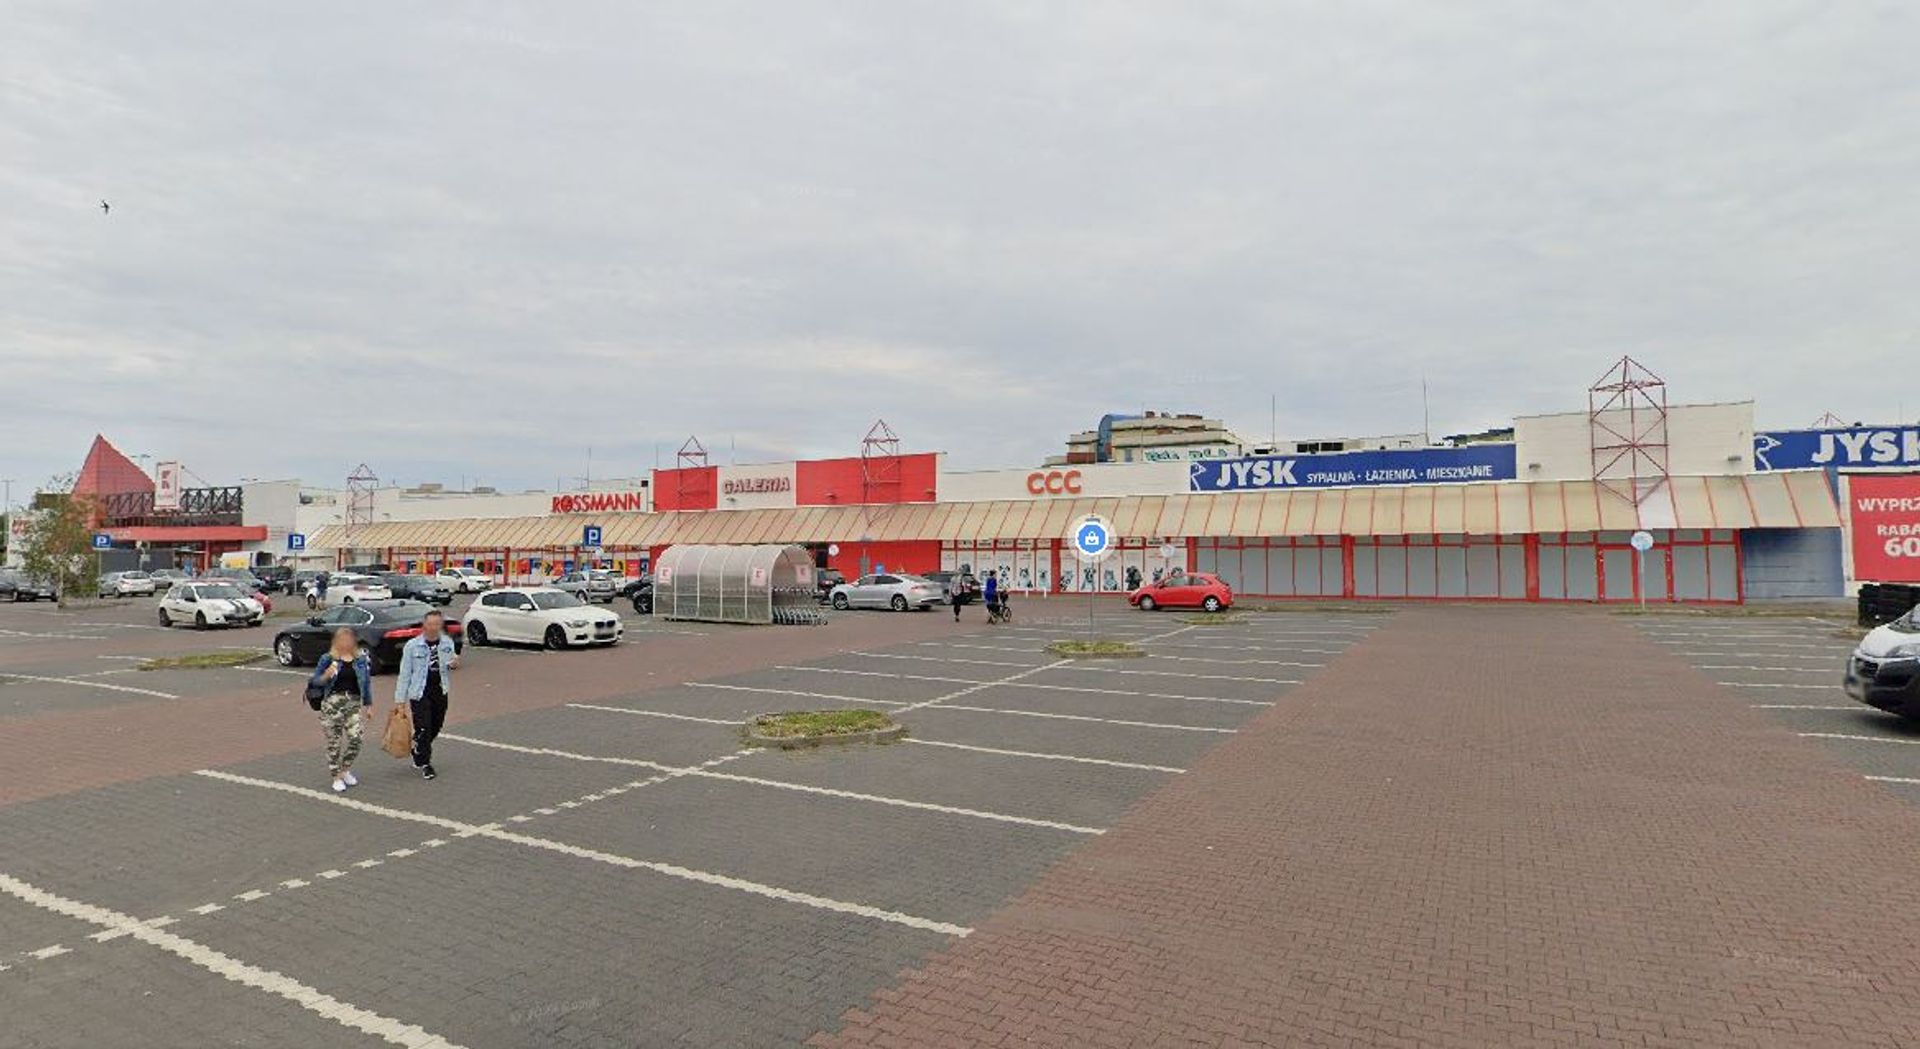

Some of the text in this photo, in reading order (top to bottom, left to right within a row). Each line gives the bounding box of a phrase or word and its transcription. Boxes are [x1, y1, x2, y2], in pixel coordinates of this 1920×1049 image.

[1027, 470, 1082, 495] CCC
[1216, 459, 1297, 487] JYSK
[1306, 465, 1493, 484] SYPIALNIA ŁAZIENKA MIESZKANIE
[723, 476, 791, 493] GALERIA
[551, 492, 641, 513] ROSSMANN
[588, 529, 599, 545] P
[1877, 524, 1920, 536] RABA
[1885, 538, 1920, 557] 60
